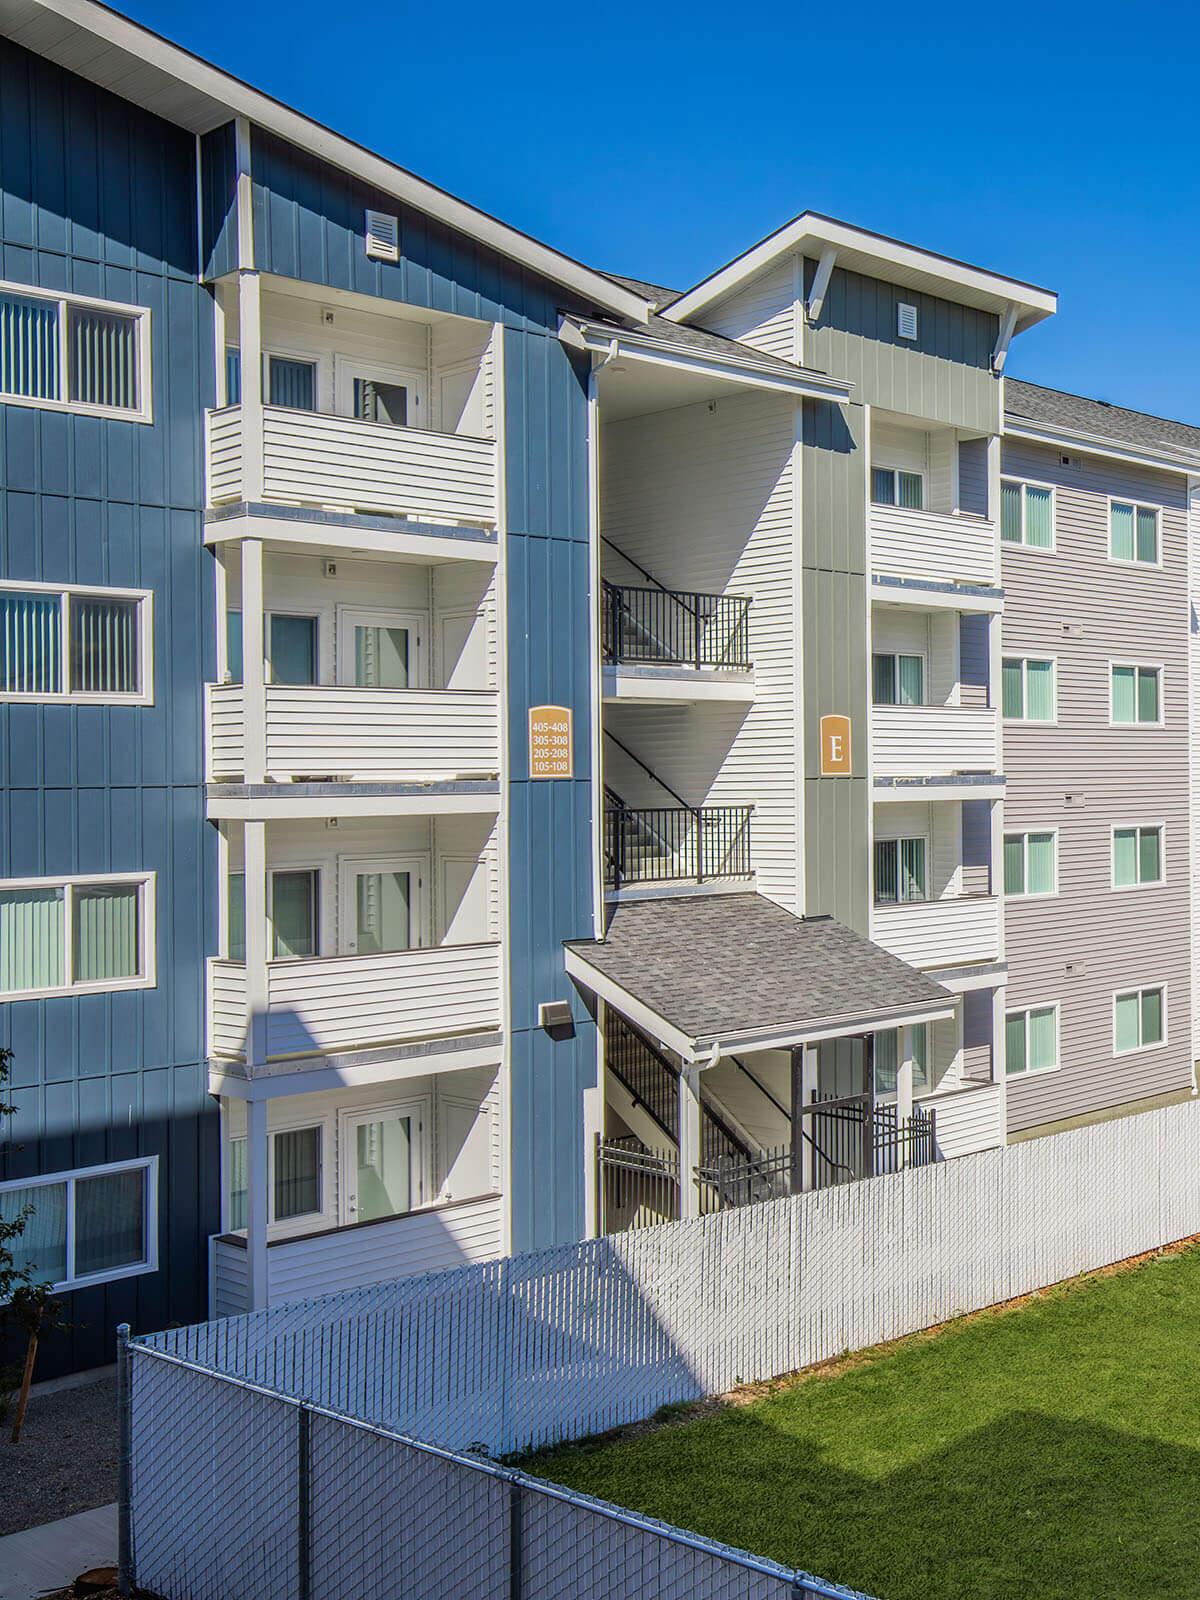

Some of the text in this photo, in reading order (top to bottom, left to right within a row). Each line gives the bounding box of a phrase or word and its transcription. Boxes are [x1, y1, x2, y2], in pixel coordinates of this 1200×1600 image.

[532, 722, 568, 732] 405-408
[533, 735, 568, 745] 305-308
[534, 748, 568, 758] 205-208
[828, 735, 844, 762] E
[535, 761, 568, 771] 105-108
